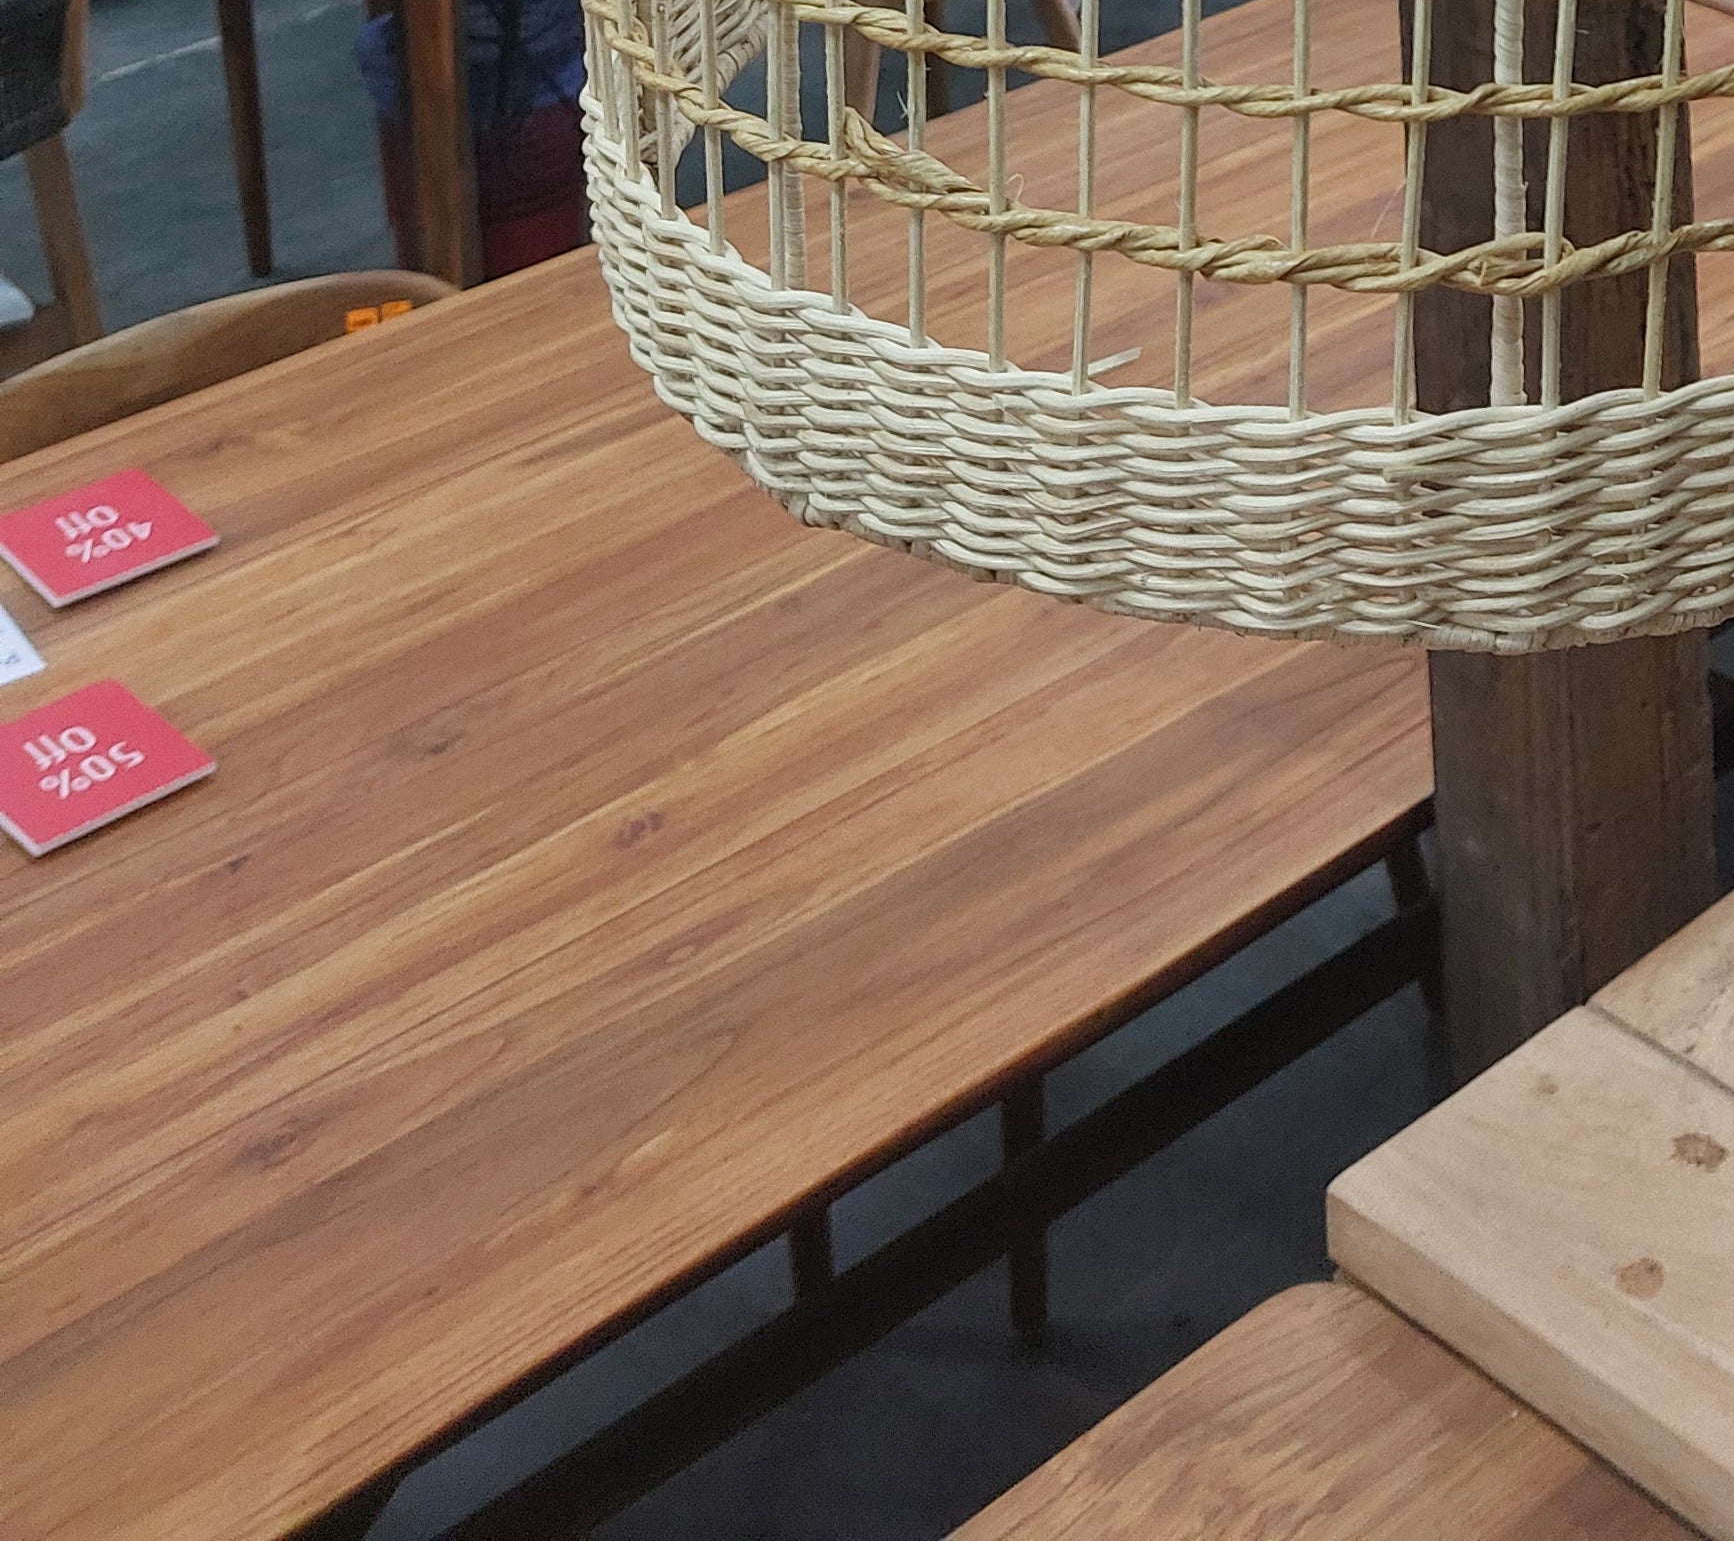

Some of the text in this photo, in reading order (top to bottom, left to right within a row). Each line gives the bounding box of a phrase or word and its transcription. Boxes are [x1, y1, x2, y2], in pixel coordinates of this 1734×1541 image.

[54, 505, 119, 540] Off
[65, 521, 152, 563] 40%
[23, 725, 97, 772] Off
[39, 741, 145, 800] 50%
